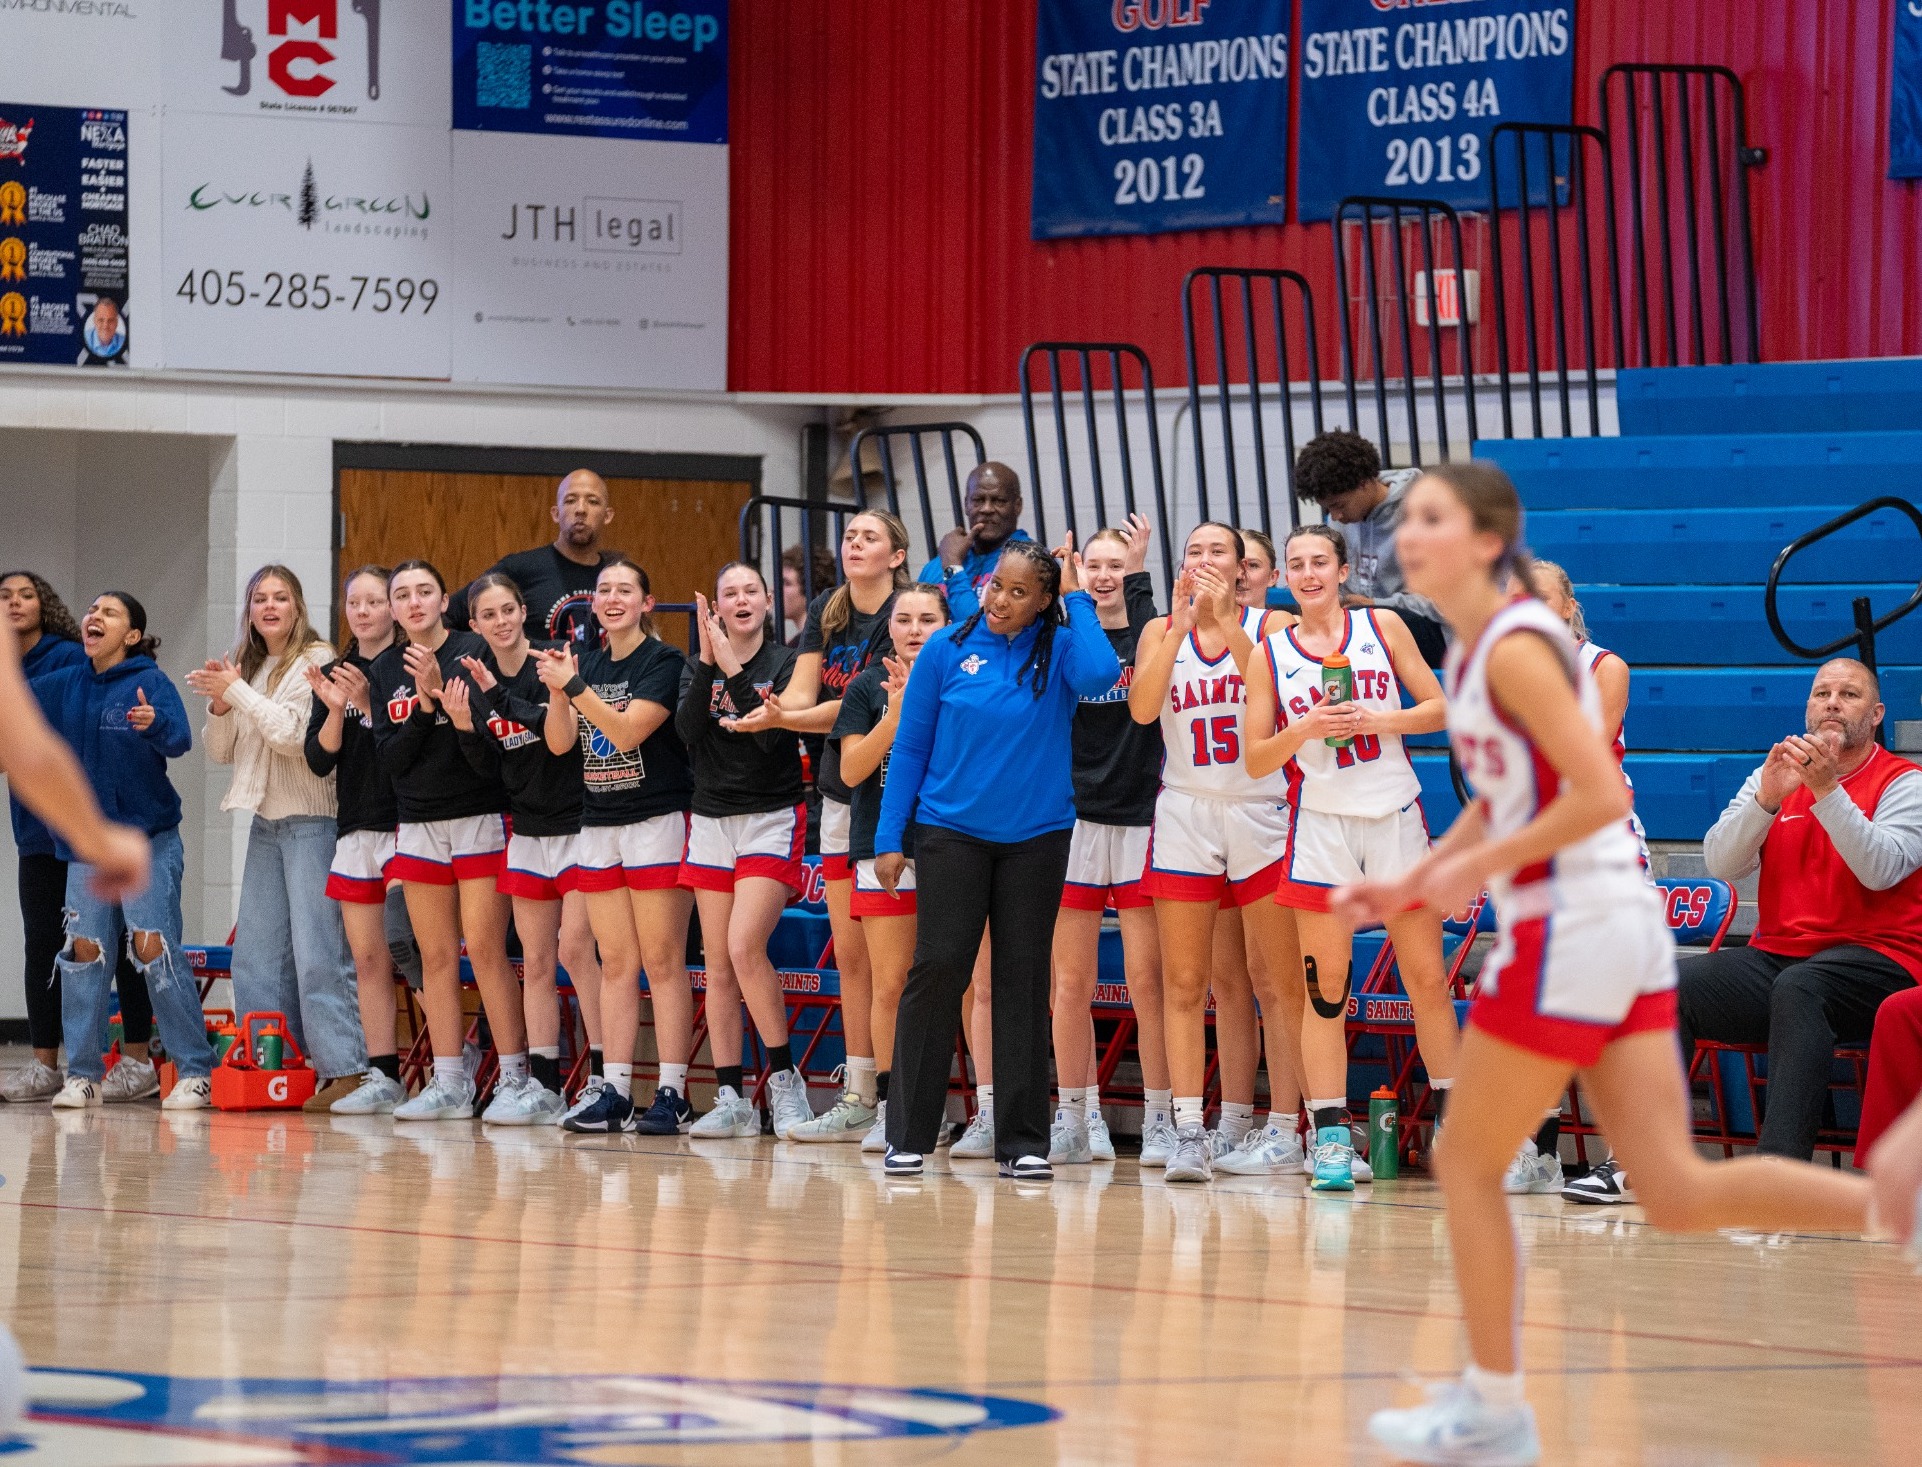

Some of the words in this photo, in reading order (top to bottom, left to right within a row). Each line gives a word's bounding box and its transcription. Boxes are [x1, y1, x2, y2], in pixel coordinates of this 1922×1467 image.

[464, 0, 595, 35] Better
[605, 0, 719, 52] Sleep
[1111, 0, 1211, 33] GOLF
[1304, 27, 1390, 78] STATE
[1395, 8, 1569, 70] CHAMPIONS
[1041, 50, 1119, 99] STATE
[1122, 33, 1288, 92] CHAMPIONS
[1099, 102, 1183, 146] CLASS
[1188, 100, 1224, 138] 3A
[1367, 81, 1457, 127] CLASS
[1462, 77, 1500, 117] 4A
[80, 124, 125, 143] NEXA
[81, 157, 125, 171] FASTER
[81, 173, 125, 188] EASIER
[1114, 153, 1205, 205] 2012
[1384, 133, 1481, 186] 2013
[325, 221, 429, 240] landscaping
[502, 203, 576, 242] JTH
[596, 209, 674, 247] legal
[176, 268, 440, 315] 405-285-7599
[504, 733, 525, 749] LADY
[1190, 714, 1240, 767] 15
[1656, 886, 1712, 928] CS
[267, 1075, 288, 1102] G
